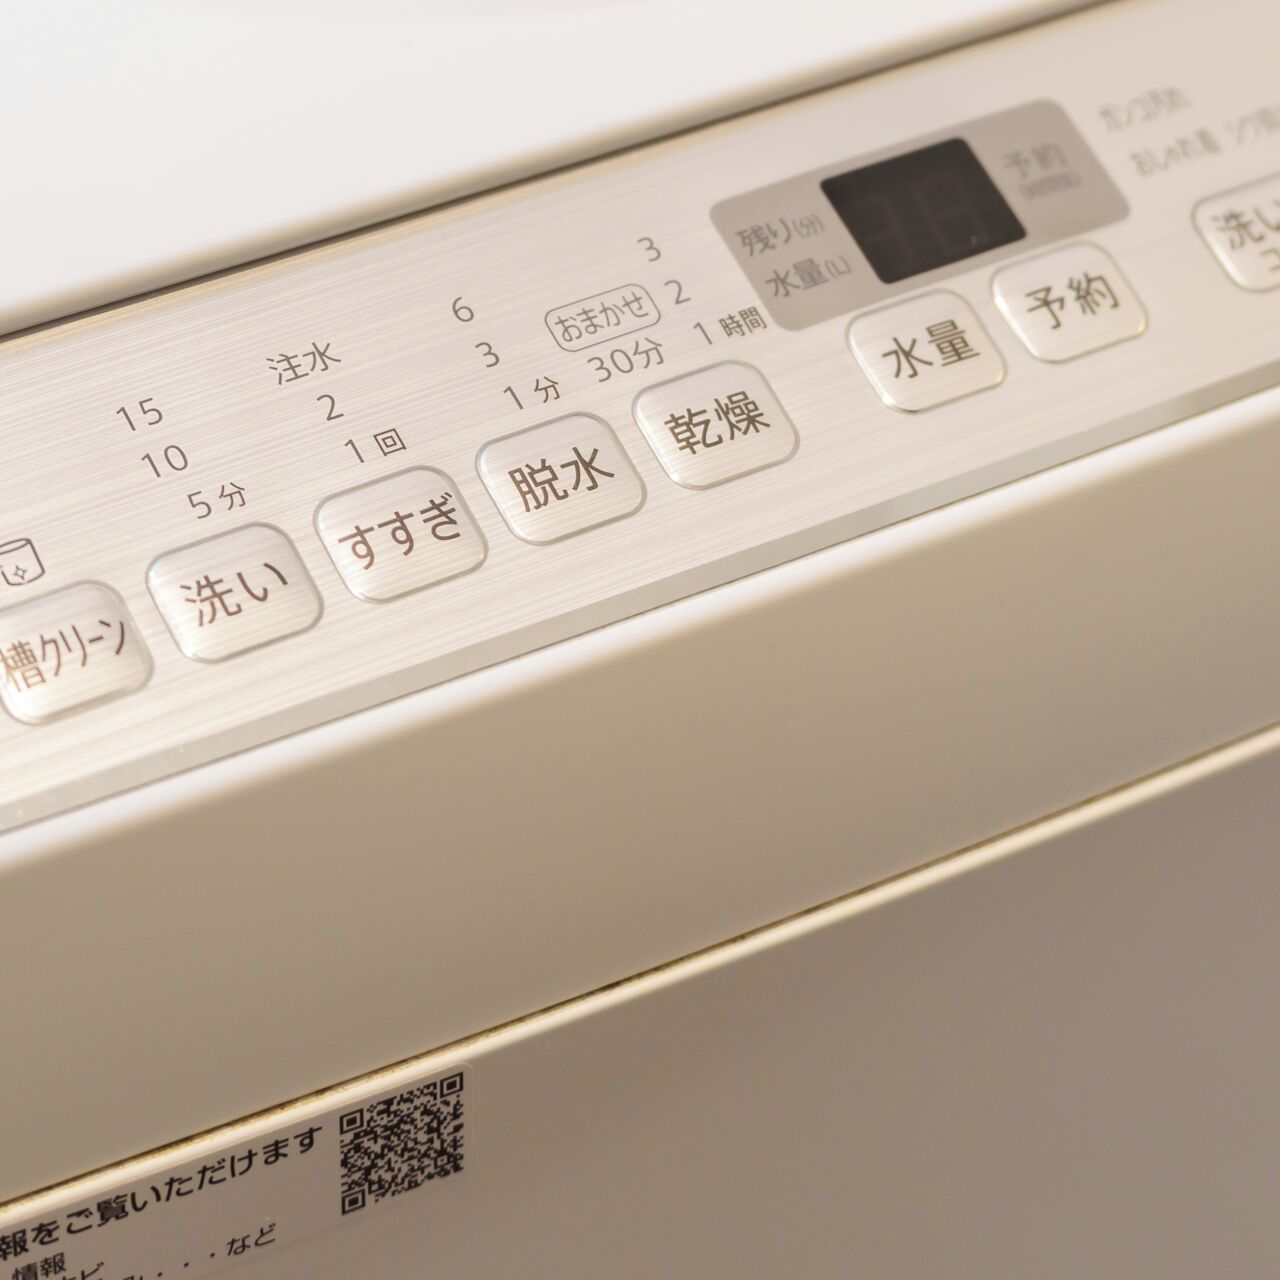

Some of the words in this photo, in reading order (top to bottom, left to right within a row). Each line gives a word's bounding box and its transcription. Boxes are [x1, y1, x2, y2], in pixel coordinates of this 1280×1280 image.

[637, 236, 662, 262] 3
[452, 296, 475, 323] 6
[664, 278, 691, 306] 2
[1025, 271, 1120, 330] 予約
[554, 290, 650, 343] おまかせ
[266, 341, 343, 386] 注水
[475, 341, 500, 368] 3
[587, 336, 665, 383] 30分
[881, 318, 981, 380] 水量
[115, 396, 164, 433] 15
[316, 393, 345, 422] 2
[663, 390, 771, 456] 乾燥
[140, 443, 189, 480] 10
[507, 445, 616, 513] 脱水
[337, 491, 462, 571] すすぎ
[179, 561, 289, 628] 洗い
